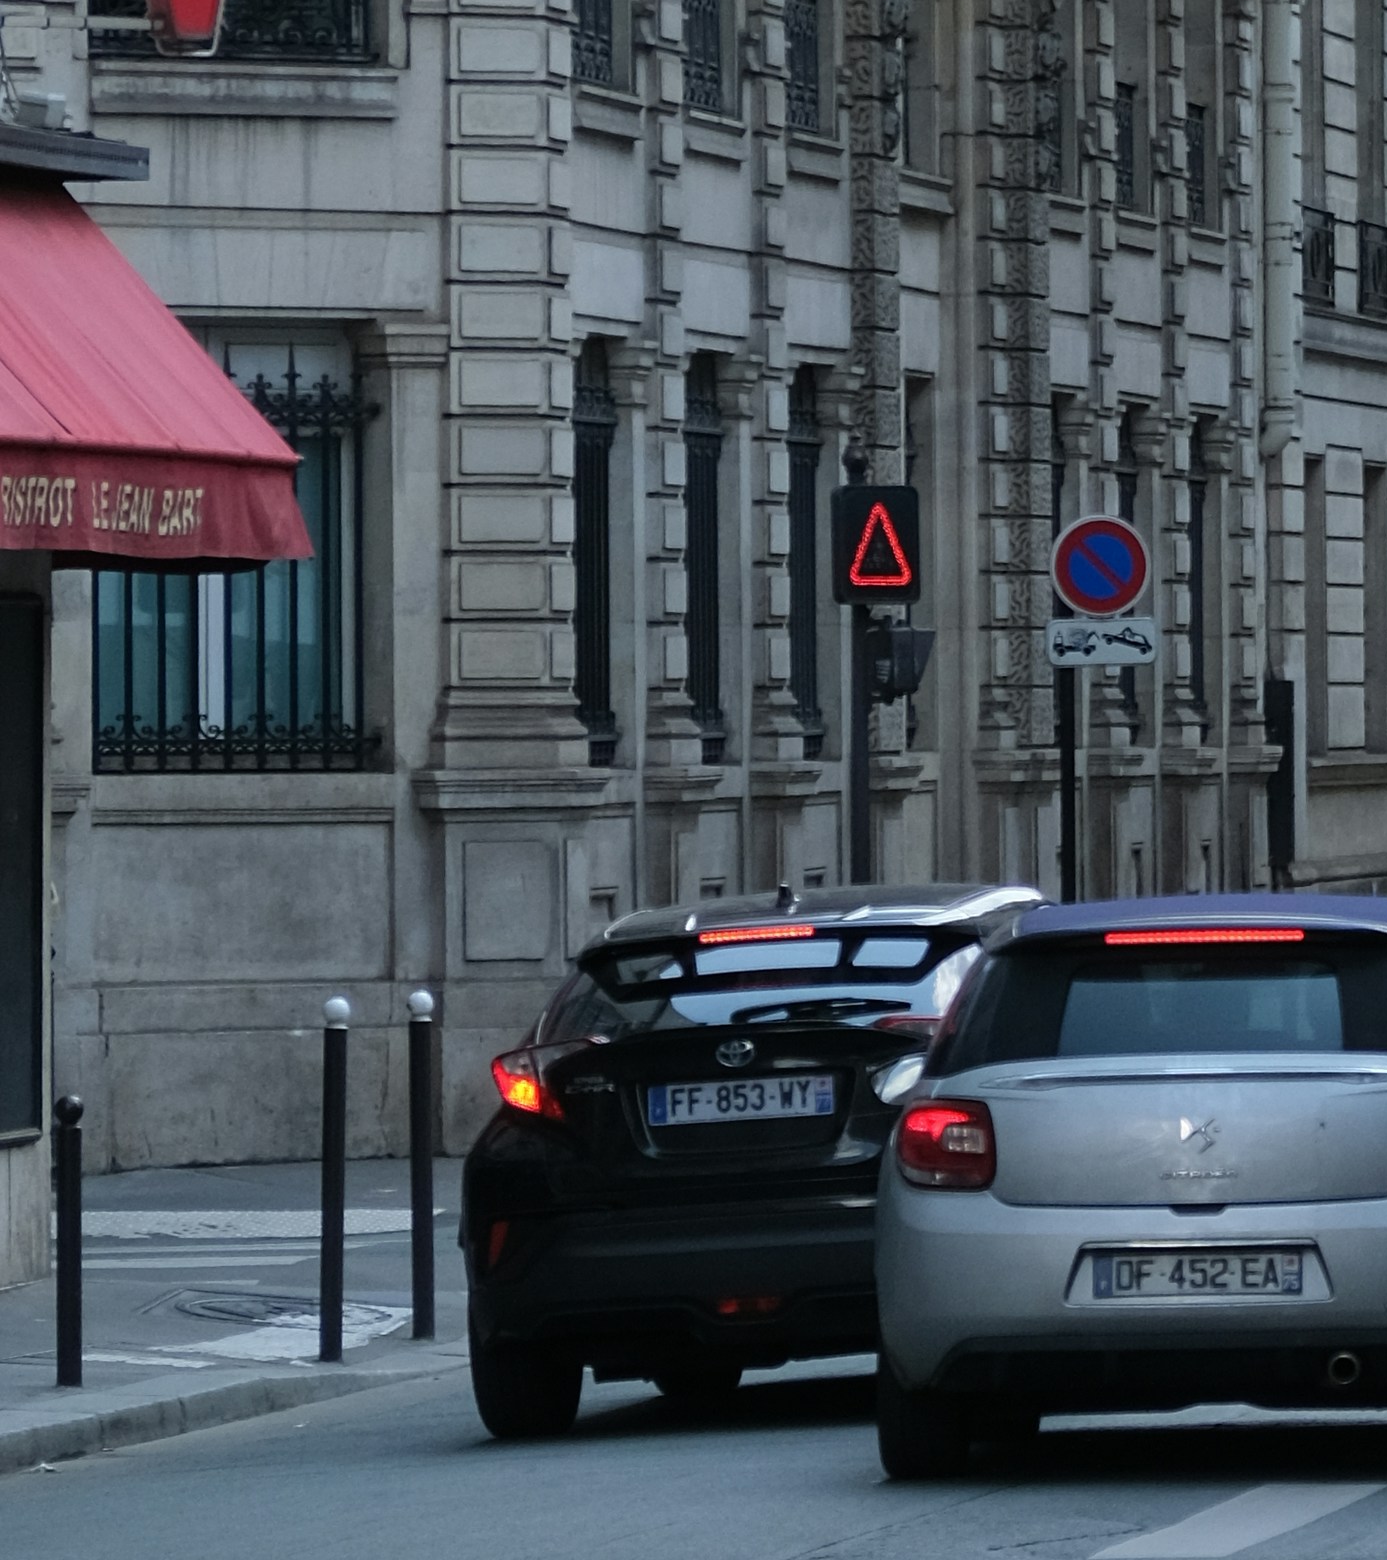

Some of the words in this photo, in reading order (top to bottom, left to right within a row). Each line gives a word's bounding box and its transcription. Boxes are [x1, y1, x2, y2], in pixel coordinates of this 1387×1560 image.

[92, 481, 109, 530] LE
[112, 483, 155, 534] JEAN
[158, 488, 204, 536] BART
[669, 1079, 811, 1118] FF-853-WY
[1115, 1257, 1279, 1291] DF-452-EA
